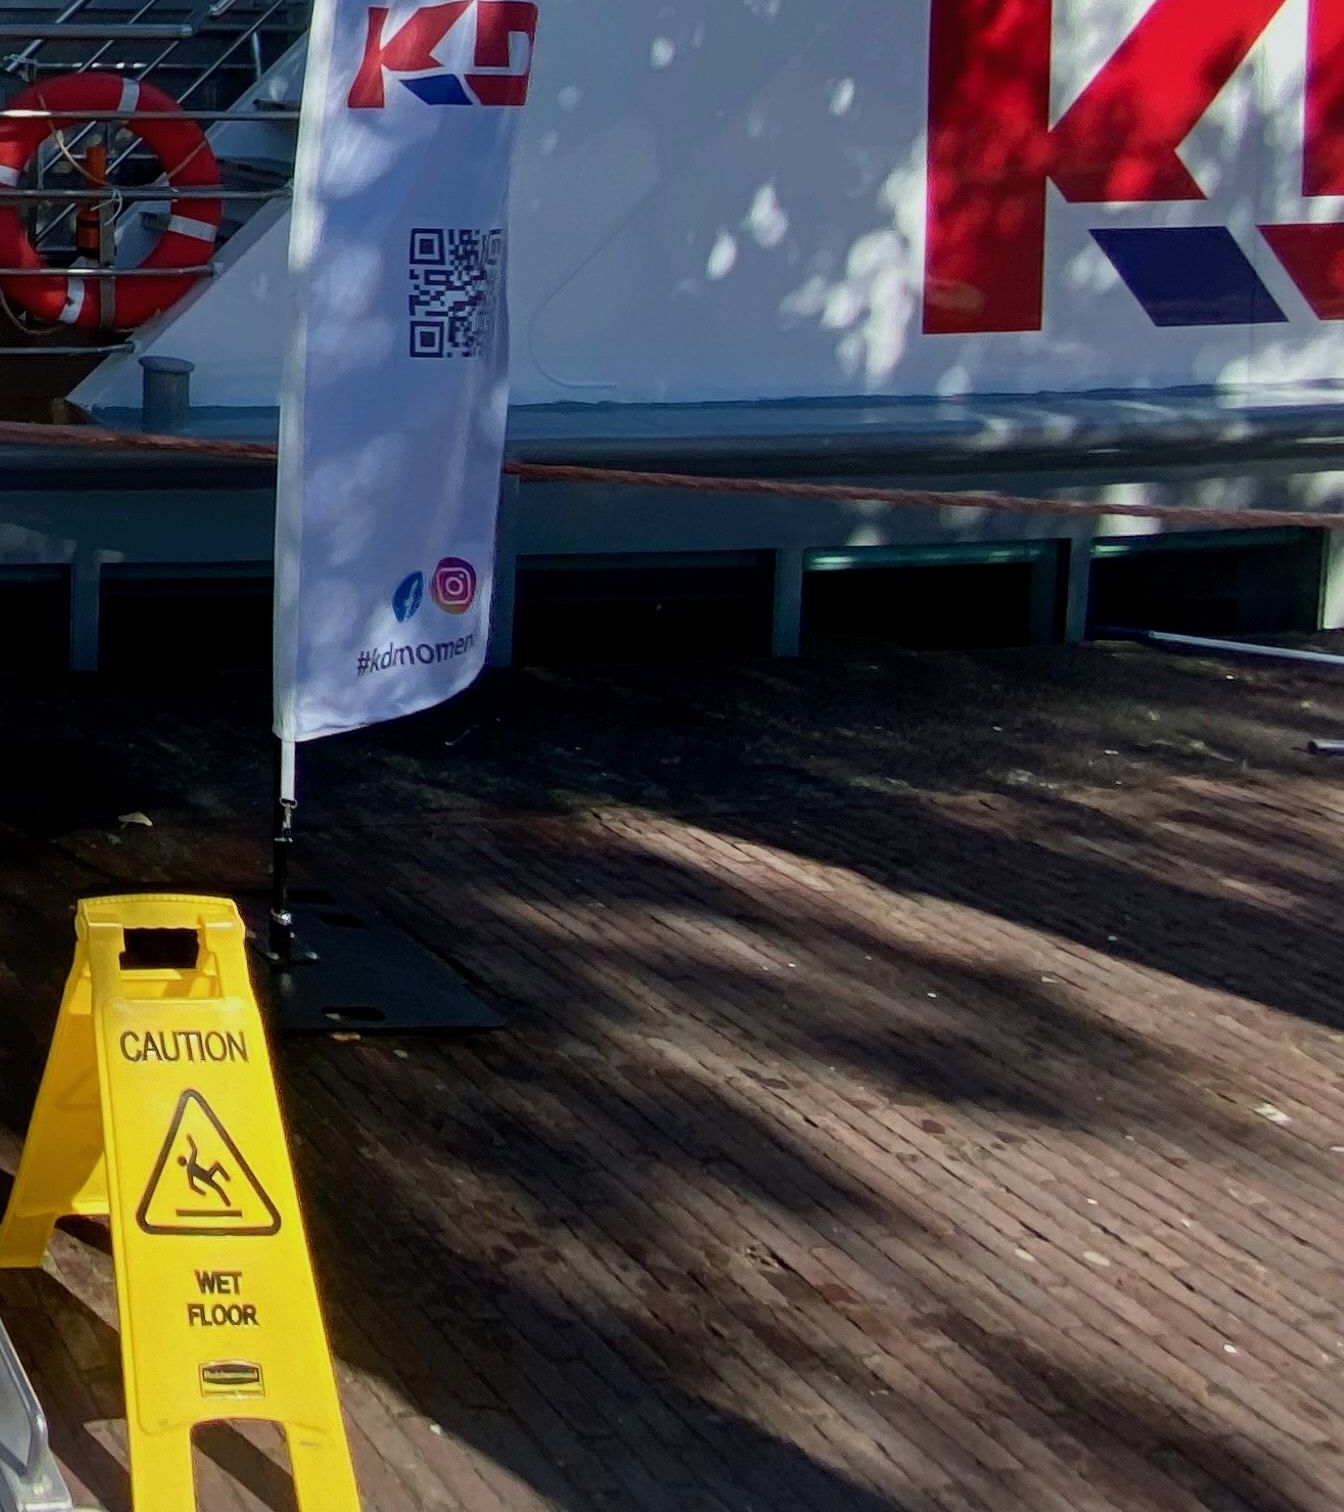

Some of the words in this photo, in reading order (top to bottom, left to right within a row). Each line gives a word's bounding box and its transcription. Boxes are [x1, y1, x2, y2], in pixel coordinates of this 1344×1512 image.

[118, 1030, 249, 1063] CAUTION
[193, 1270, 243, 1295] WET
[187, 1303, 259, 1328] FLOOR
